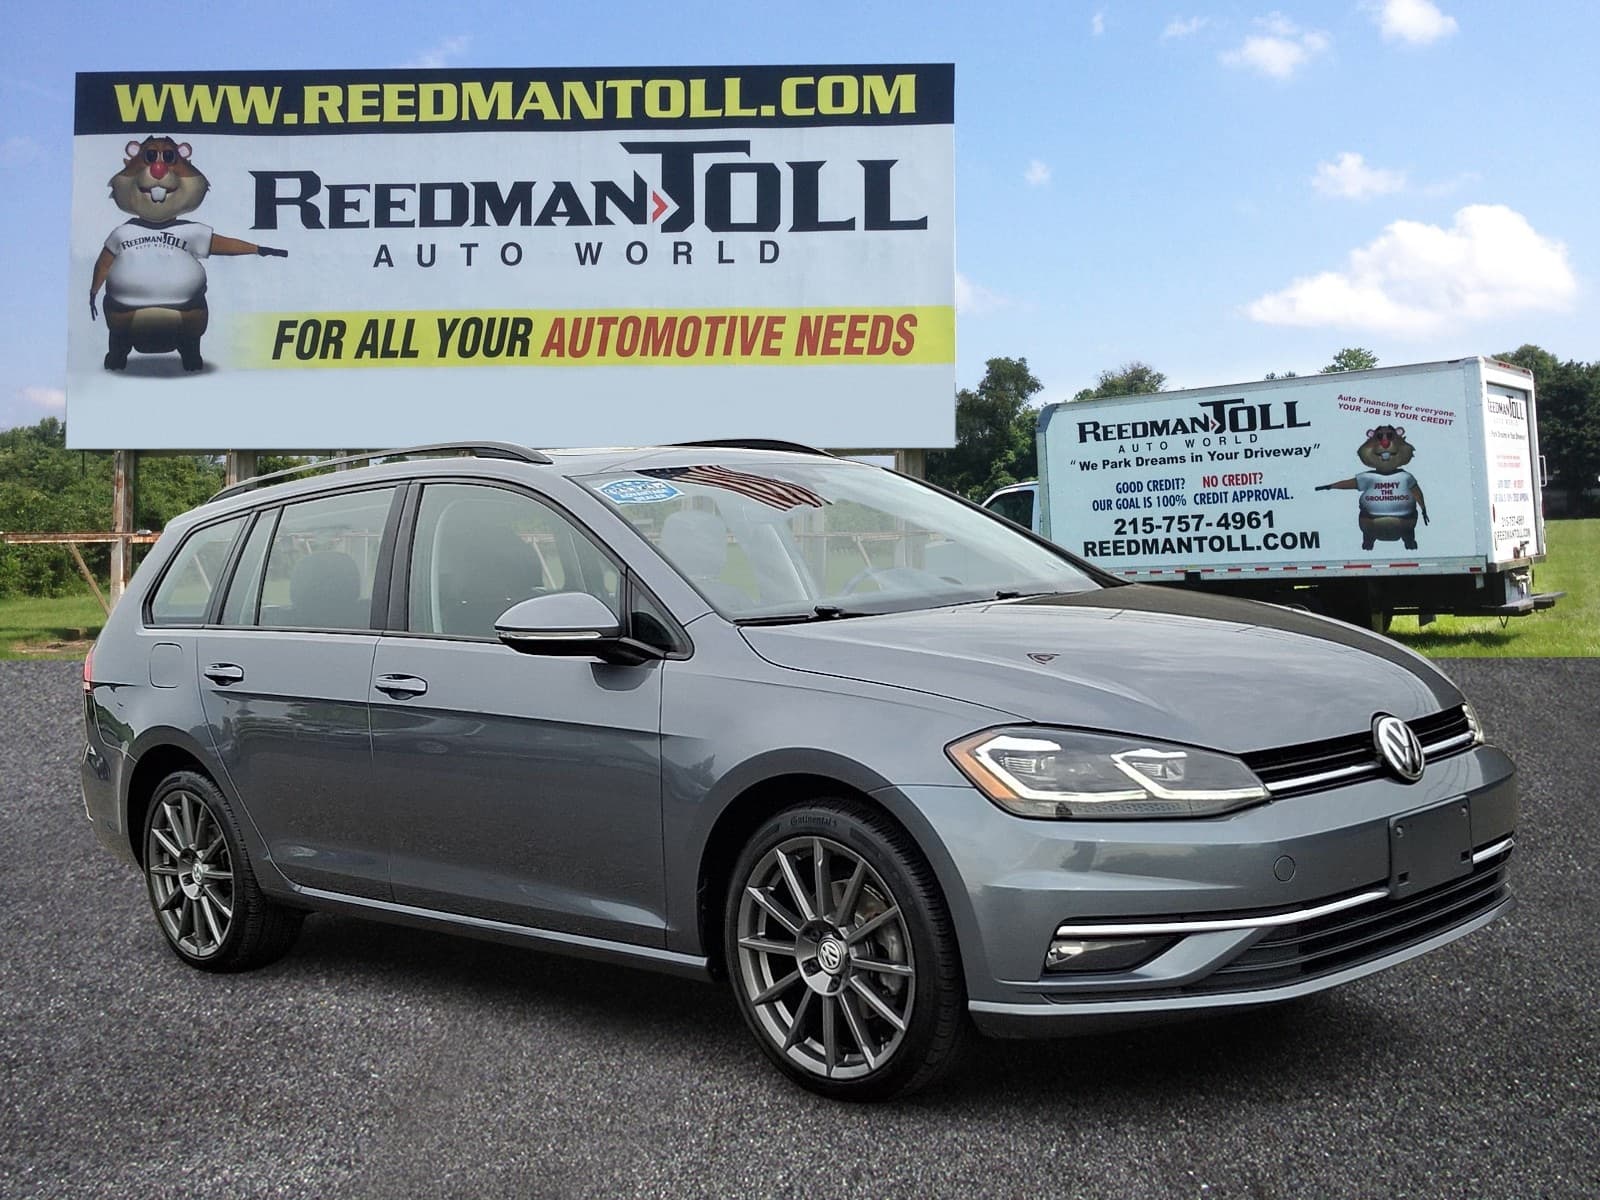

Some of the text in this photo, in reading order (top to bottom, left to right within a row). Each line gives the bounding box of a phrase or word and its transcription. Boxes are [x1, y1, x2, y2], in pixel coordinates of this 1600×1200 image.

[114, 74, 917, 125] WWW.REEDMANTOLL.COM
[373, 239, 781, 268] AUTO WORLD
[272, 313, 918, 361] FOR ALL YOUR AUTOMOTIVE NEEDS
[1337, 394, 1457, 418] Auto Financing for everyone.
[1338, 403, 1454, 426] YOUR JOB IS YOUR CREDIT
[1118, 433, 1258, 454] AUTO WORLD
[1102, 457, 1131, 470] Park
[1136, 454, 1187, 467] Dreams
[1191, 452, 1203, 463] in
[1208, 450, 1240, 462] Your
[1116, 472, 1264, 494] GOOD CREDIT? NO CREDIT?
[1374, 482, 1400, 490] JIMMY
[1092, 487, 1294, 512] OUR GOAL IS 100% CREDIT APPROVAL.
[1083, 531, 1321, 558] REEDMANTOLL.COM
